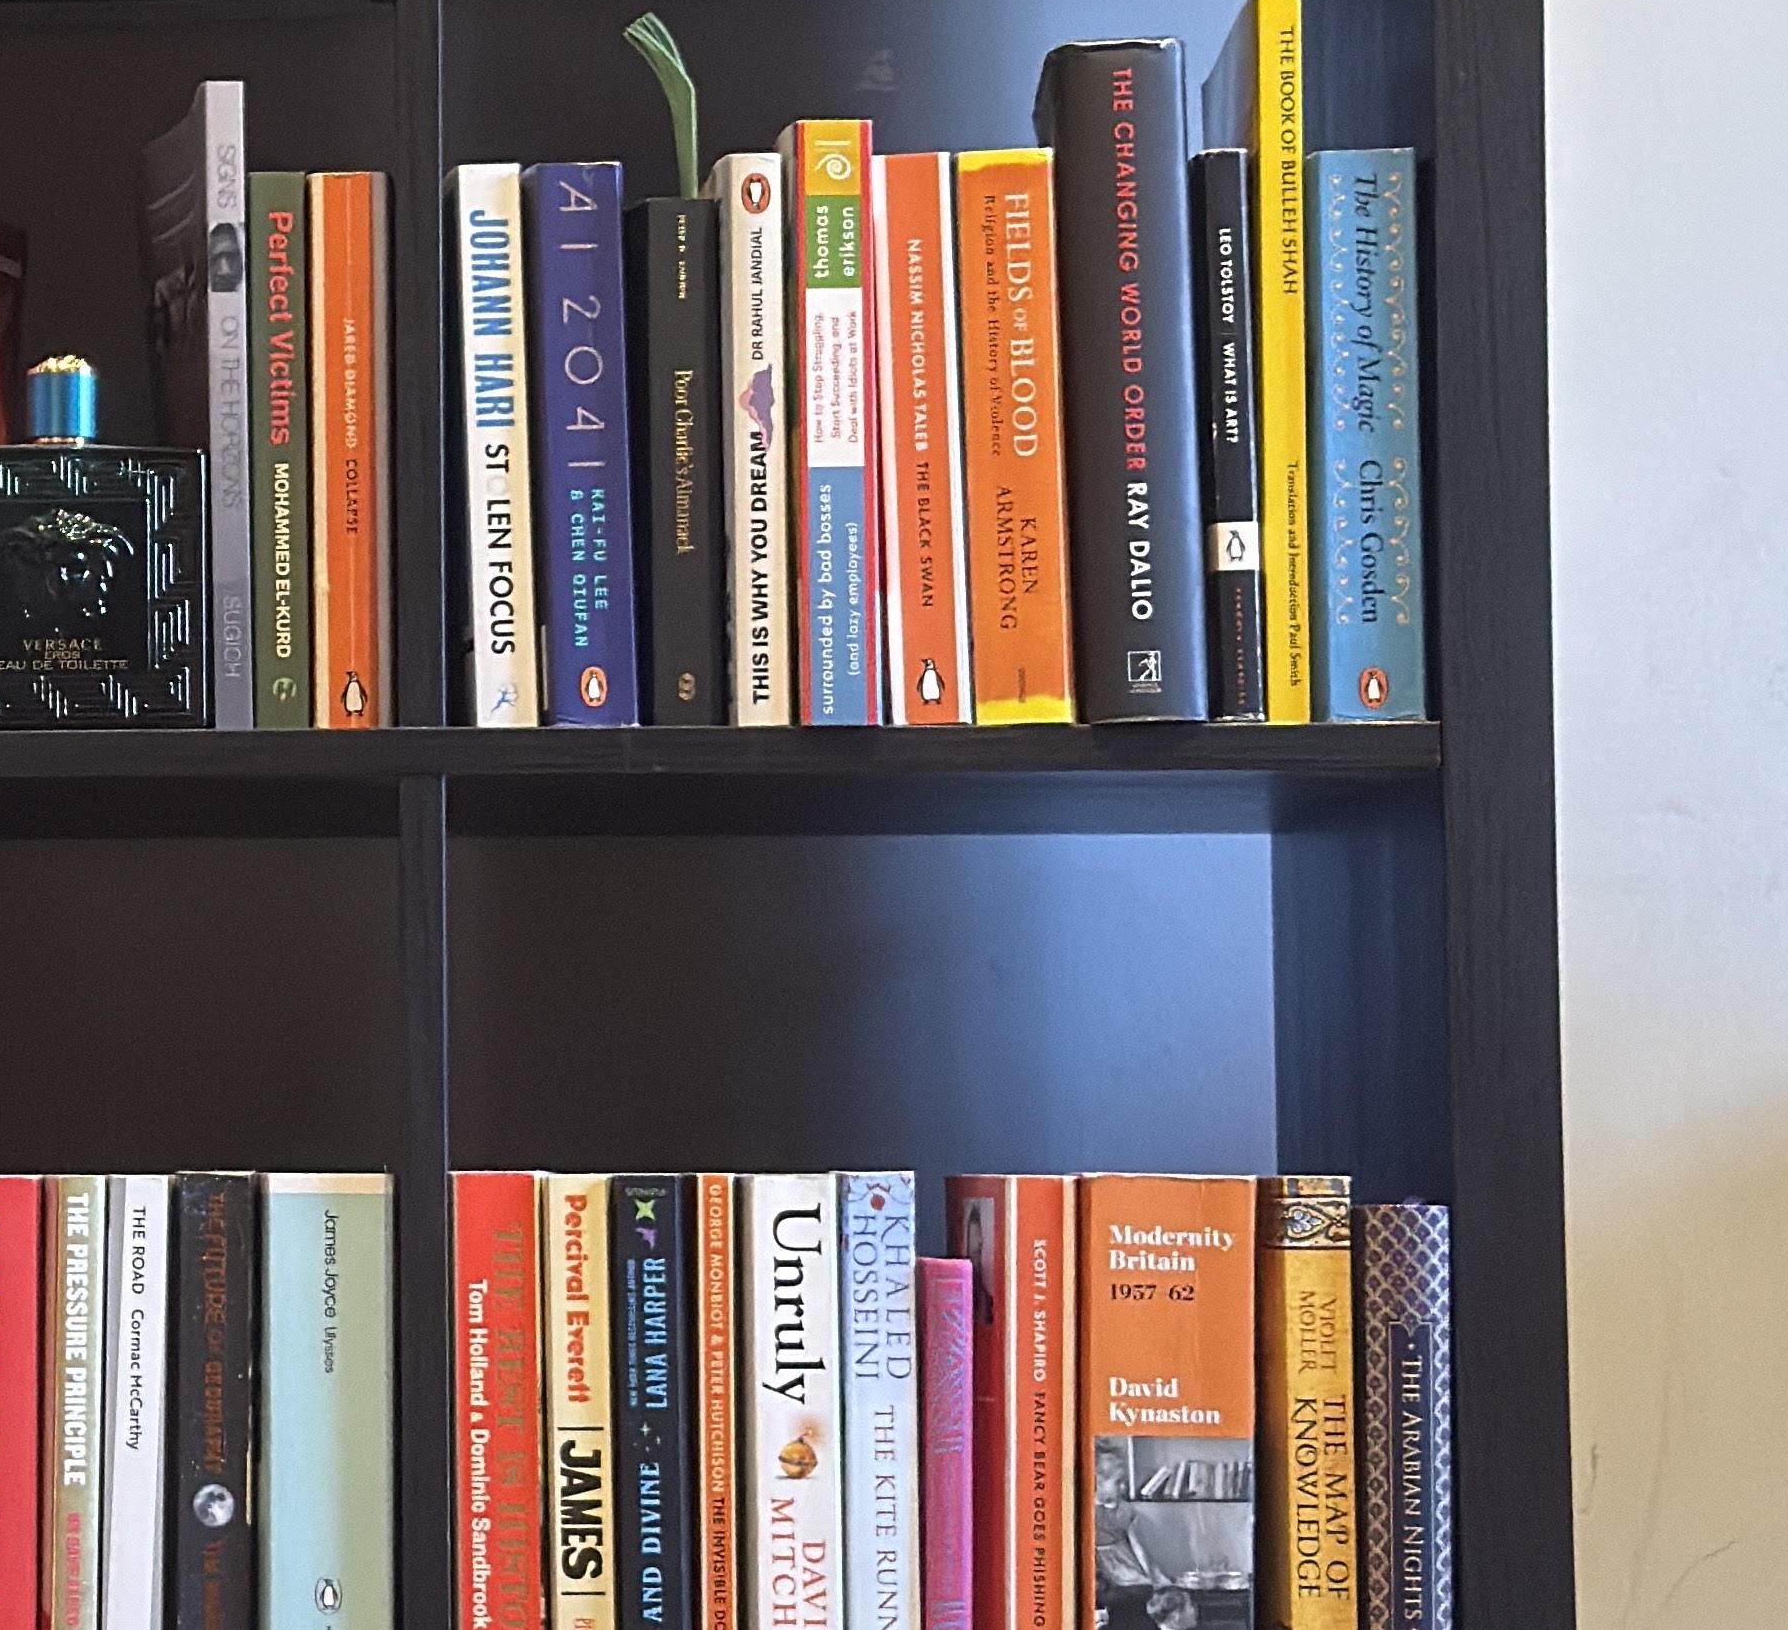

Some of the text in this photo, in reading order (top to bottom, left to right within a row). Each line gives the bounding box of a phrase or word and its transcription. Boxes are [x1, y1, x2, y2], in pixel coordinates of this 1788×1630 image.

[267, 212, 293, 446] Perfect Victims
[469, 210, 515, 428] JOHANN HARI
[1352, 173, 1379, 433] The History of Magic
[274, 464, 291, 659] MOHAMMED EL-KURD
[750, 432, 769, 704] THIS IS WHY YOU DREAM
[917, 462, 933, 607] THE BLACK SWAN
[1126, 482, 1152, 619] RAY DALIO
[1359, 460, 1383, 623] Chris Gosden
[23, 639, 102, 650] VERSACE
[33, 660, 53, 670] DE
[58, 660, 128, 670] TOILETTE
[488, 562, 515, 655] FOCUS
[131, 1206, 146, 1293] THE ROAD
[322, 1209, 337, 1318] James Joyce
[762, 1203, 827, 1404] Unruly
[852, 1215, 880, 1380] HOSSEINI
[882, 1215, 912, 1380] KHALED
[1109, 1225, 1235, 1251] Modernity
[1109, 1249, 1196, 1271] Britain
[126, 1310, 144, 1450] Cormac McCarthy
[643, 1258, 667, 1408] LANA HARPER
[1110, 1377, 1178, 1398] David
[1109, 1402, 1221, 1427] Kynaston
[559, 1441, 604, 1582] JAMES
[642, 1461, 663, 1554] DIVINE
[1402, 1355, 1422, 1621] THE ARABIAN NIGHTS
[642, 1566, 663, 1622] AND
